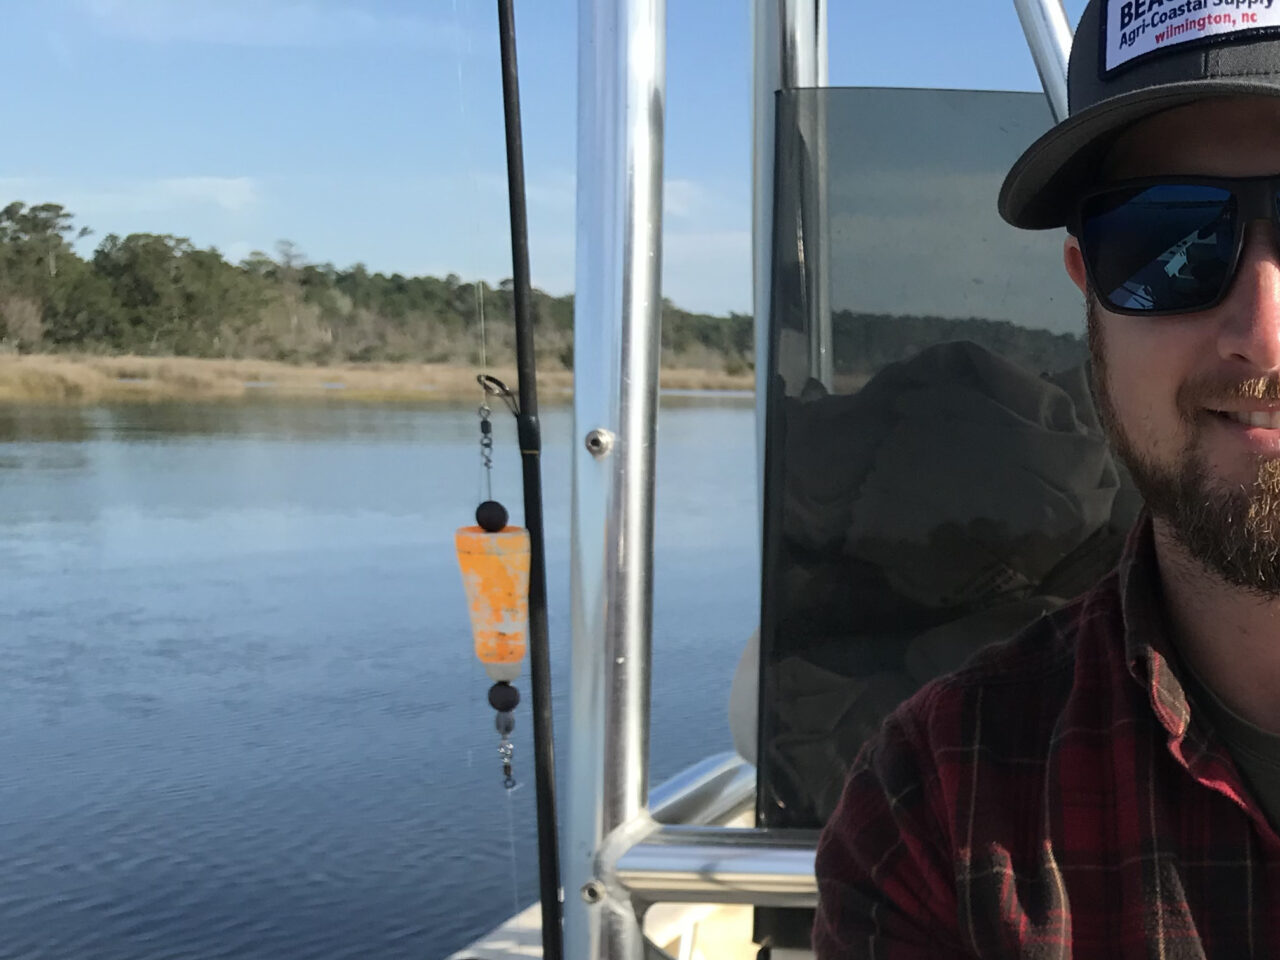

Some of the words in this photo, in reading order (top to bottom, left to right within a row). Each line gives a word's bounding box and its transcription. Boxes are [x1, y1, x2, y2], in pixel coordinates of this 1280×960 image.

[1119, 0, 1208, 49] Agri-Coastal
[1120, 0, 1173, 31] BEA
[1155, 13, 1236, 44] wilmington,
[1241, 12, 1258, 23] nc
